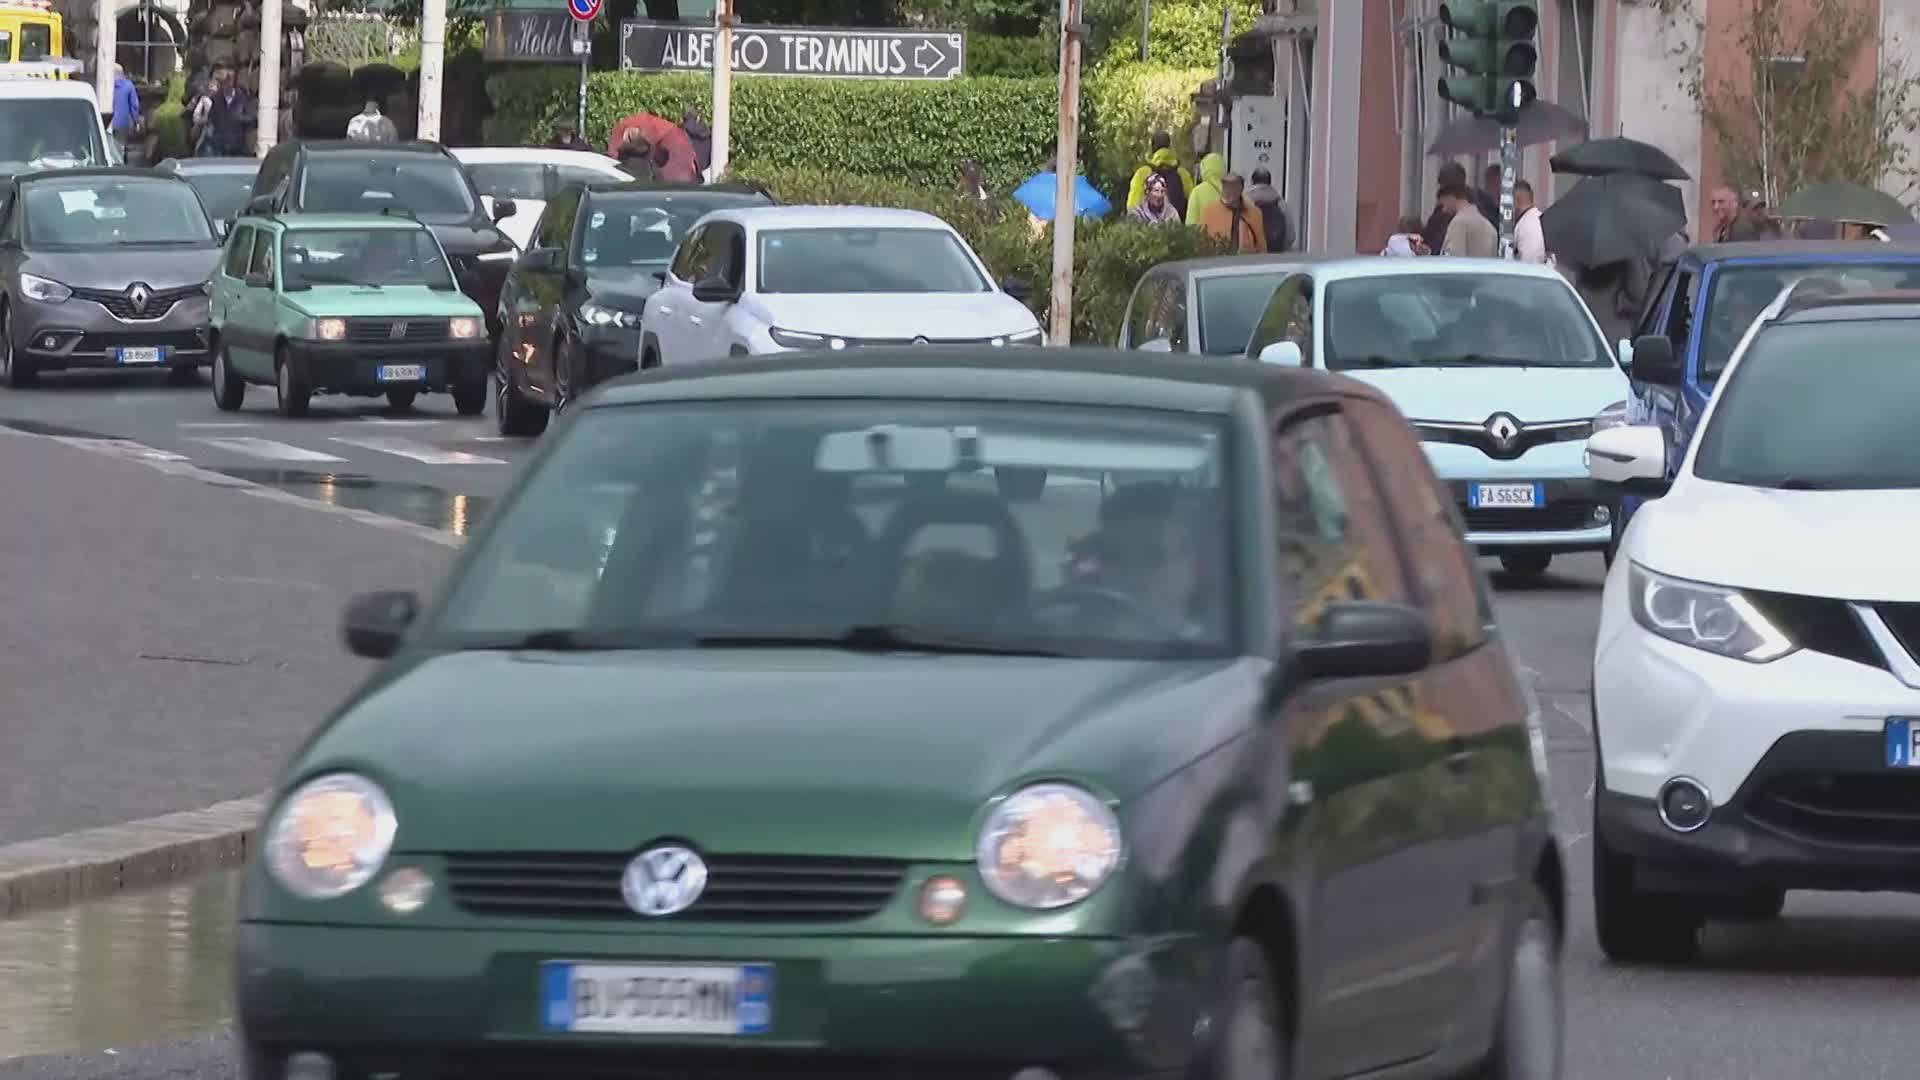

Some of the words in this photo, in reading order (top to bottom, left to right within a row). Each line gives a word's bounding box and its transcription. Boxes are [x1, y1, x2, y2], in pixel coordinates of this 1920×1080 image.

[512, 16, 568, 53] Hotel
[661, 31, 768, 70] ALBEGO
[780, 36, 906, 74] TERMINUS
